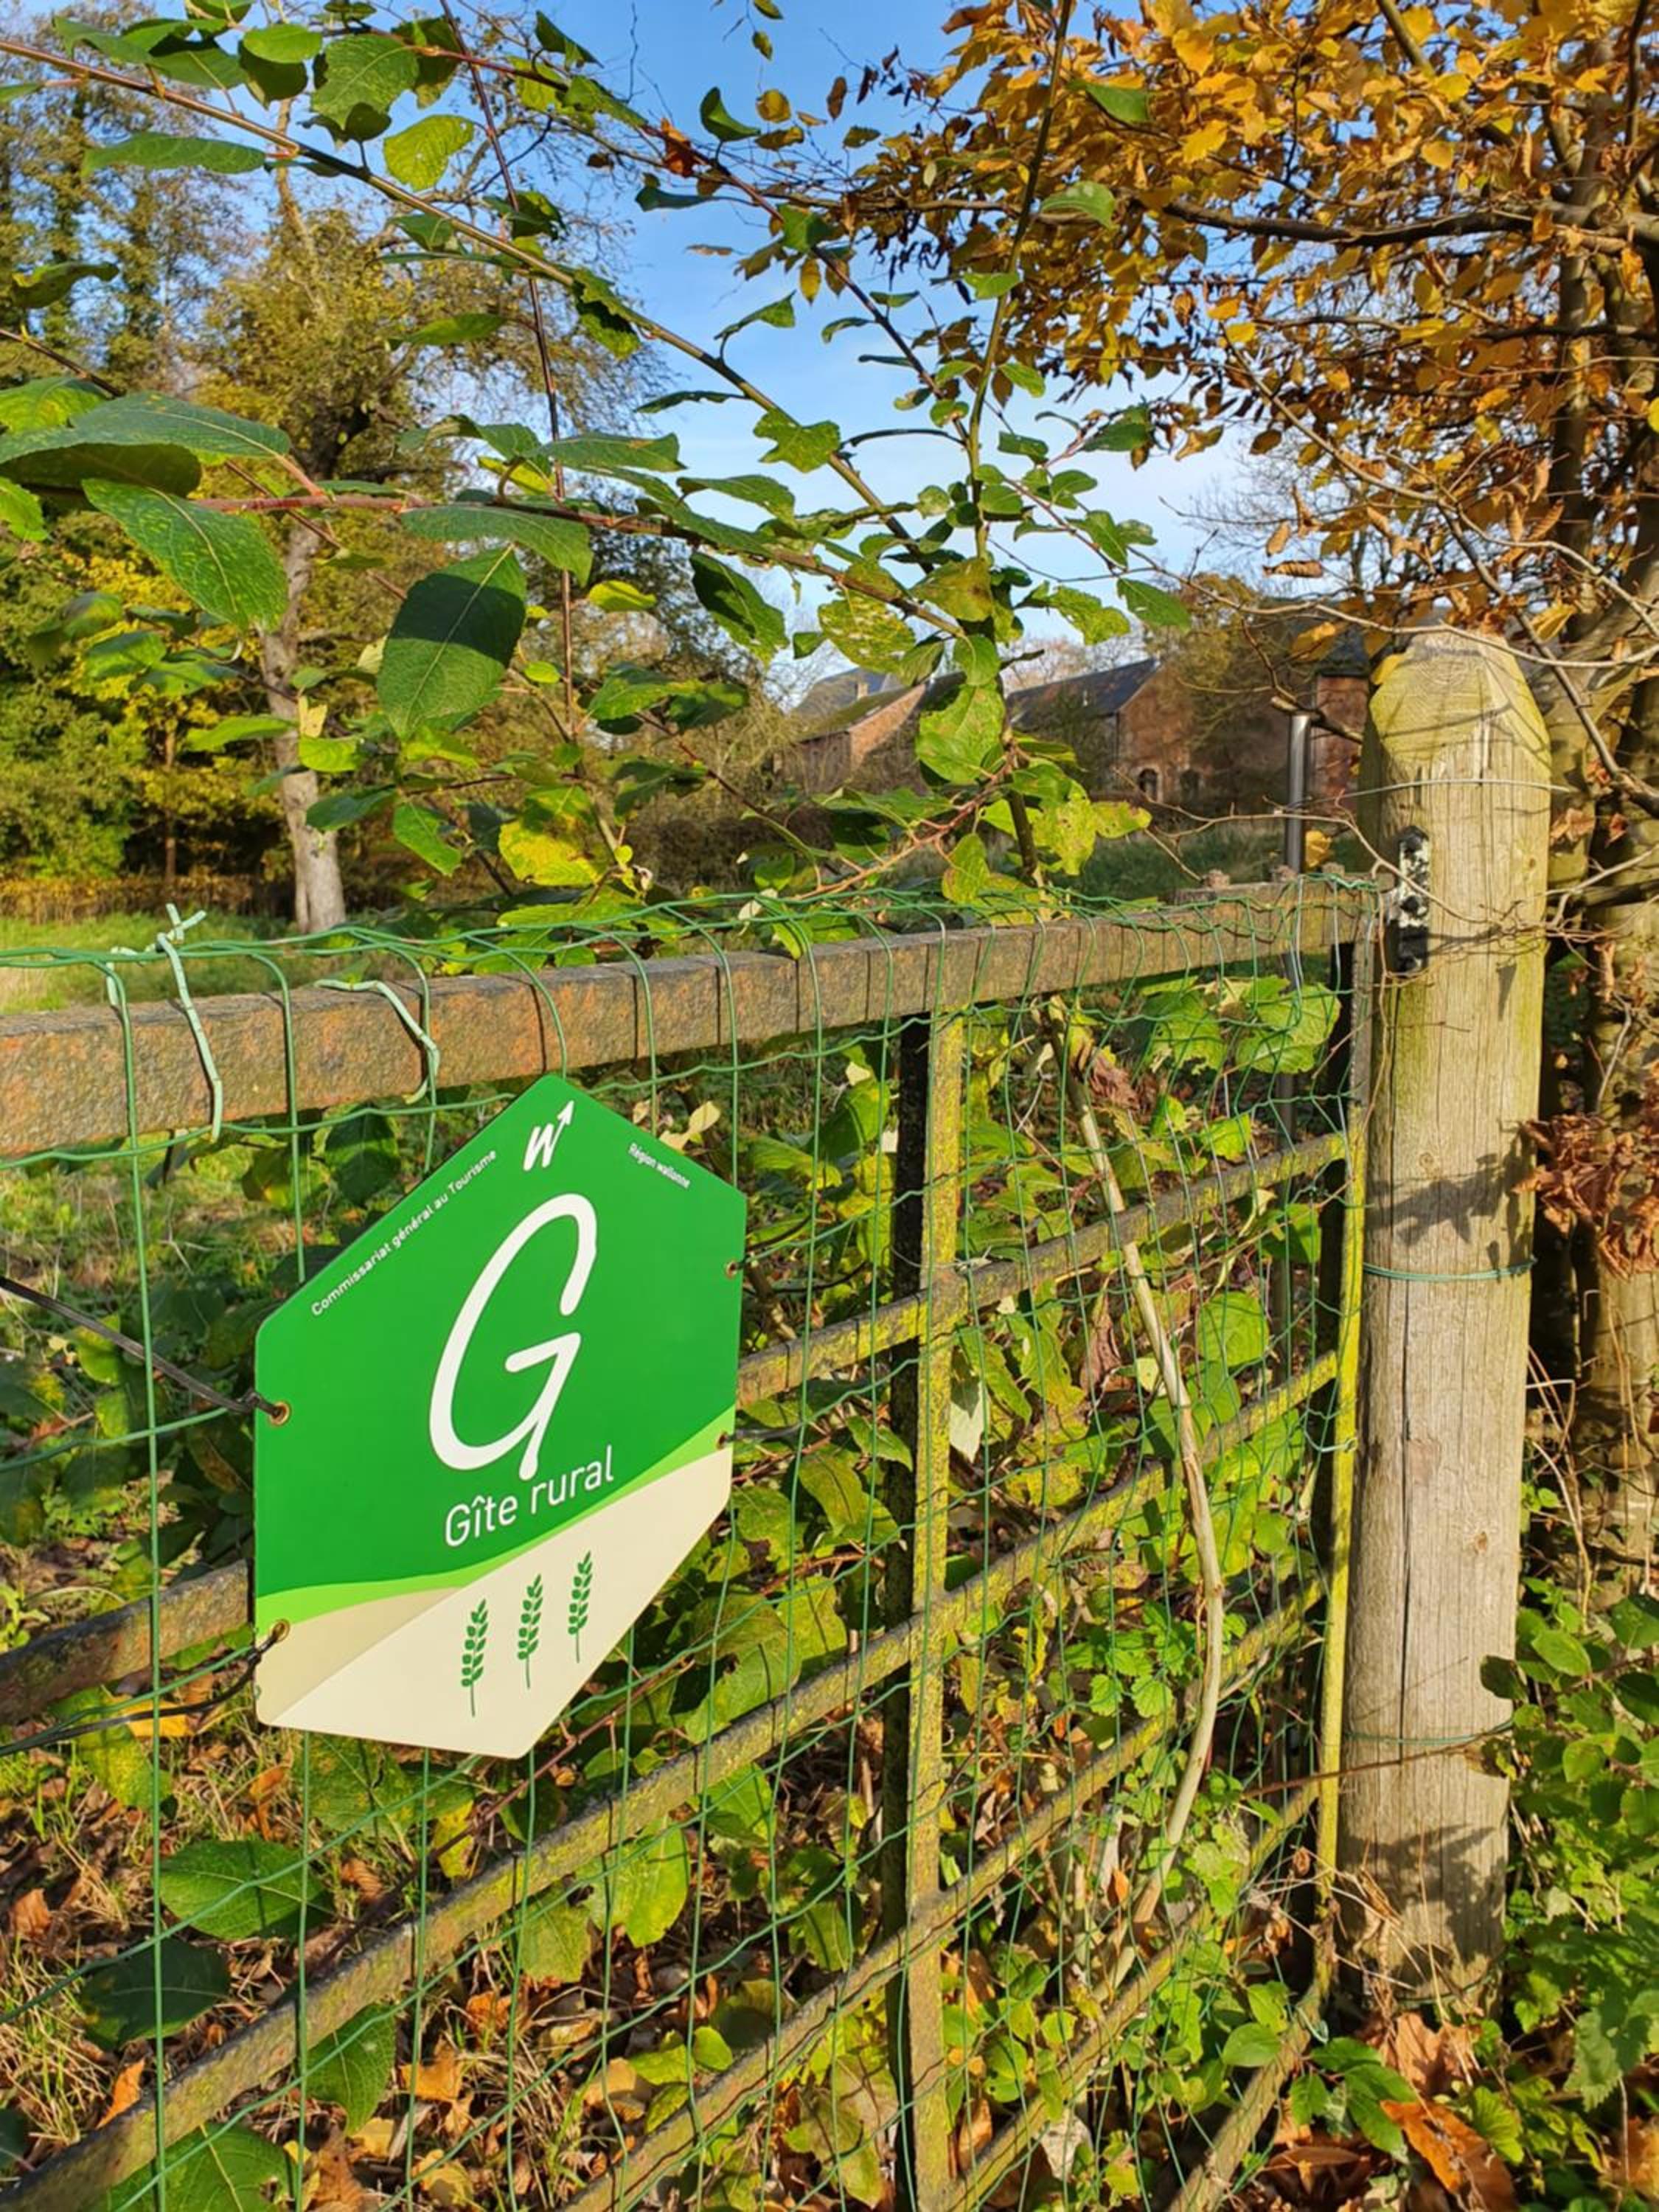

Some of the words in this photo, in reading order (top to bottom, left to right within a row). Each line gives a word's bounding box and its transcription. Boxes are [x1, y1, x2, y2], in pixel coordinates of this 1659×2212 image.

[628, 1143, 657, 1168] Région
[311, 1244, 392, 1315] Commissariat
[392, 1205, 434, 1248] général
[434, 1193, 448, 1209] au
[448, 1150, 496, 1193] Tourisme
[429, 1193, 597, 1481] G
[445, 1495, 518, 1546] Gîte
[531, 1445, 614, 1514] rural
